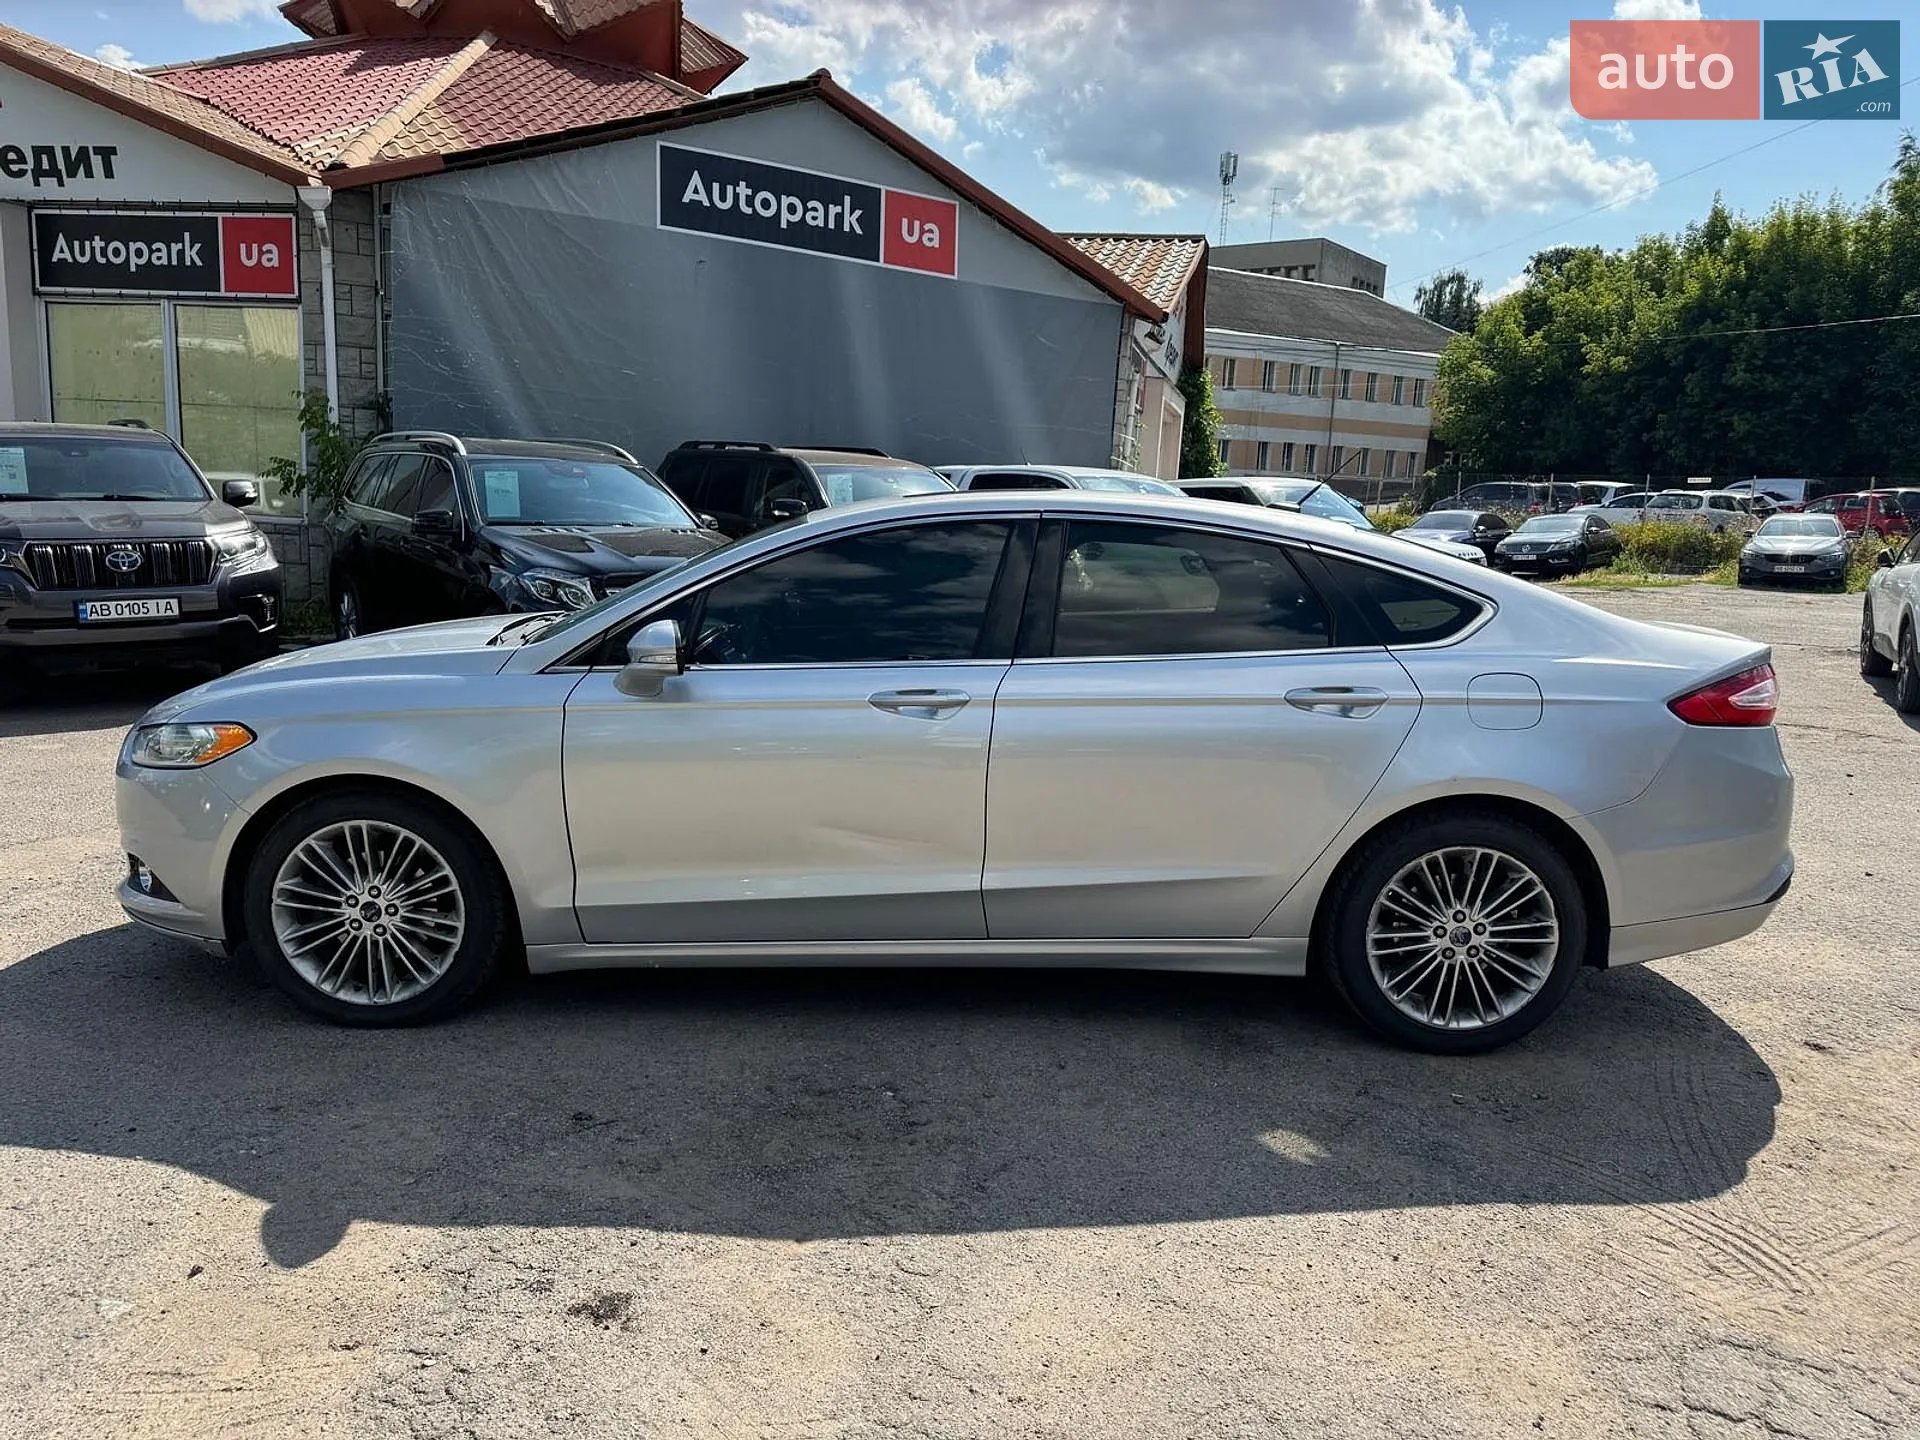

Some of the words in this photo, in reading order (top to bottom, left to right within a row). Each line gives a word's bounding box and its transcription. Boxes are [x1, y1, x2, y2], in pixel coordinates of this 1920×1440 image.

[681, 169, 863, 235] Autopark
[901, 217, 941, 249] ua
[51, 231, 203, 272] Autopark
[239, 242, 280, 268] ua
[88, 604, 112, 618] AB
[114, 602, 150, 617] 0105
